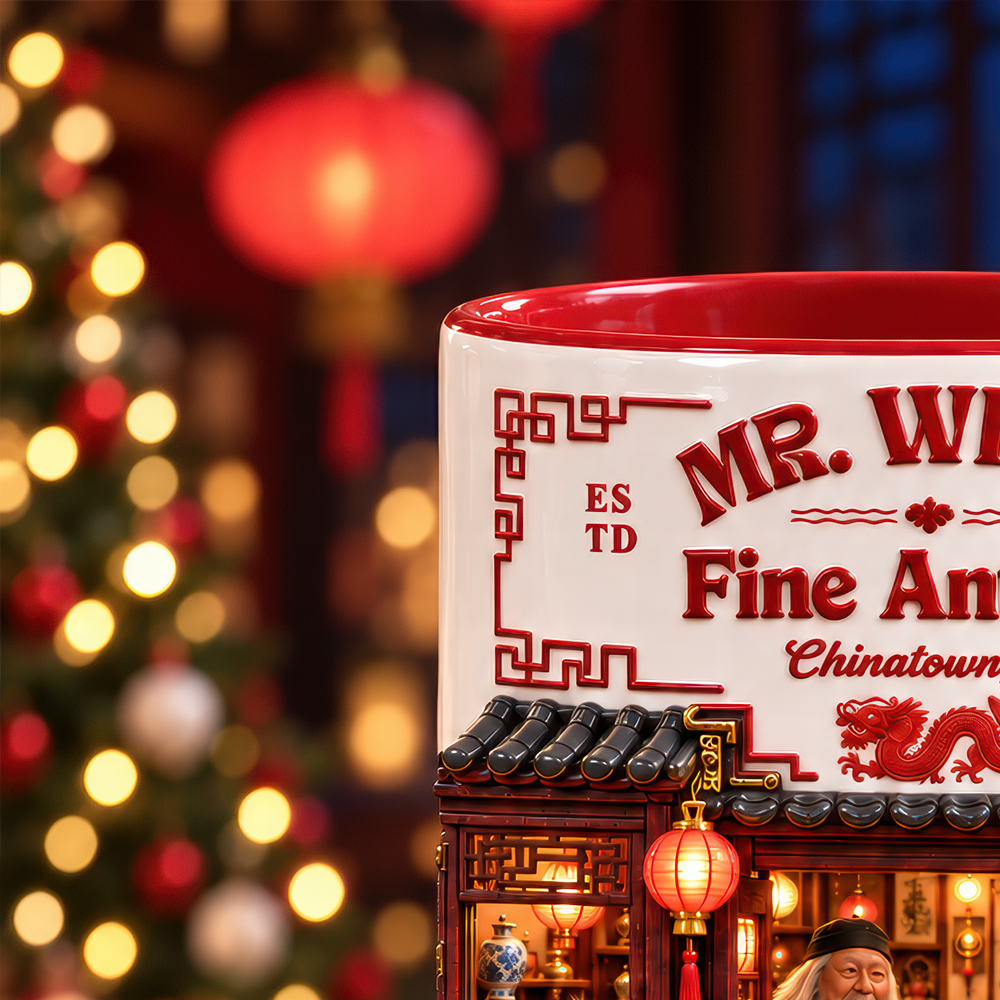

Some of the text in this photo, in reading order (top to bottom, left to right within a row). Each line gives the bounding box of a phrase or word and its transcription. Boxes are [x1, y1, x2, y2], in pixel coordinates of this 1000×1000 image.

[676, 403, 853, 527] MR.
[584, 483, 632, 514] ES
[584, 523, 638, 554] TD
[681, 547, 858, 622] Fine
